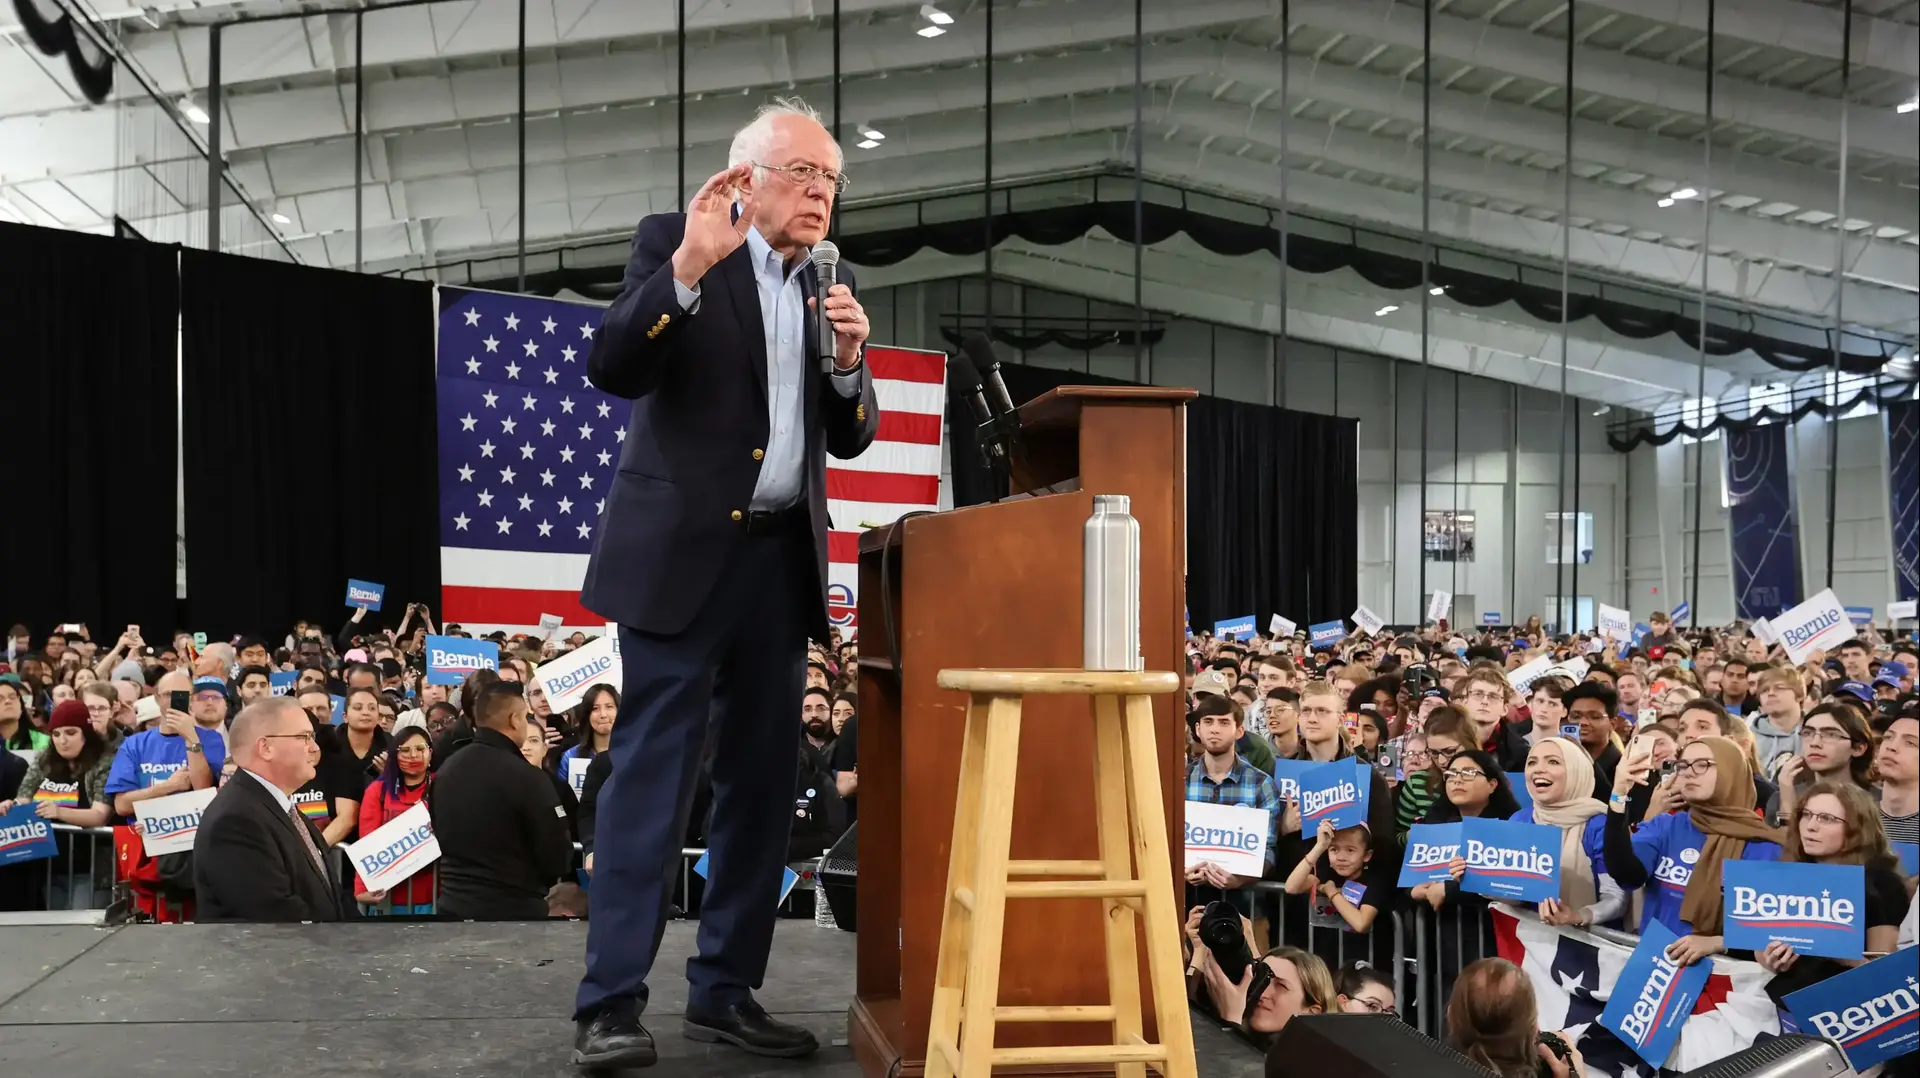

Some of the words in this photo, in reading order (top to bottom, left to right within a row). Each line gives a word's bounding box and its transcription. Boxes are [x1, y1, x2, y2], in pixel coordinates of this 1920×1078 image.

[350, 586, 381, 602] Bernie
[1217, 622, 1254, 637] Bernie
[1312, 627, 1343, 640] Bernie
[1782, 608, 1841, 647] Bernie
[431, 649, 495, 671] Bernie
[546, 655, 612, 697] Bernie
[1302, 779, 1355, 813] Bernie
[0, 819, 47, 847] ernie
[143, 807, 201, 835] Berni
[360, 824, 433, 875] Bernie
[1467, 839, 1554, 874] Bernie
[1733, 886, 1855, 924] Bernie
[1808, 975, 1919, 1043] Berni
